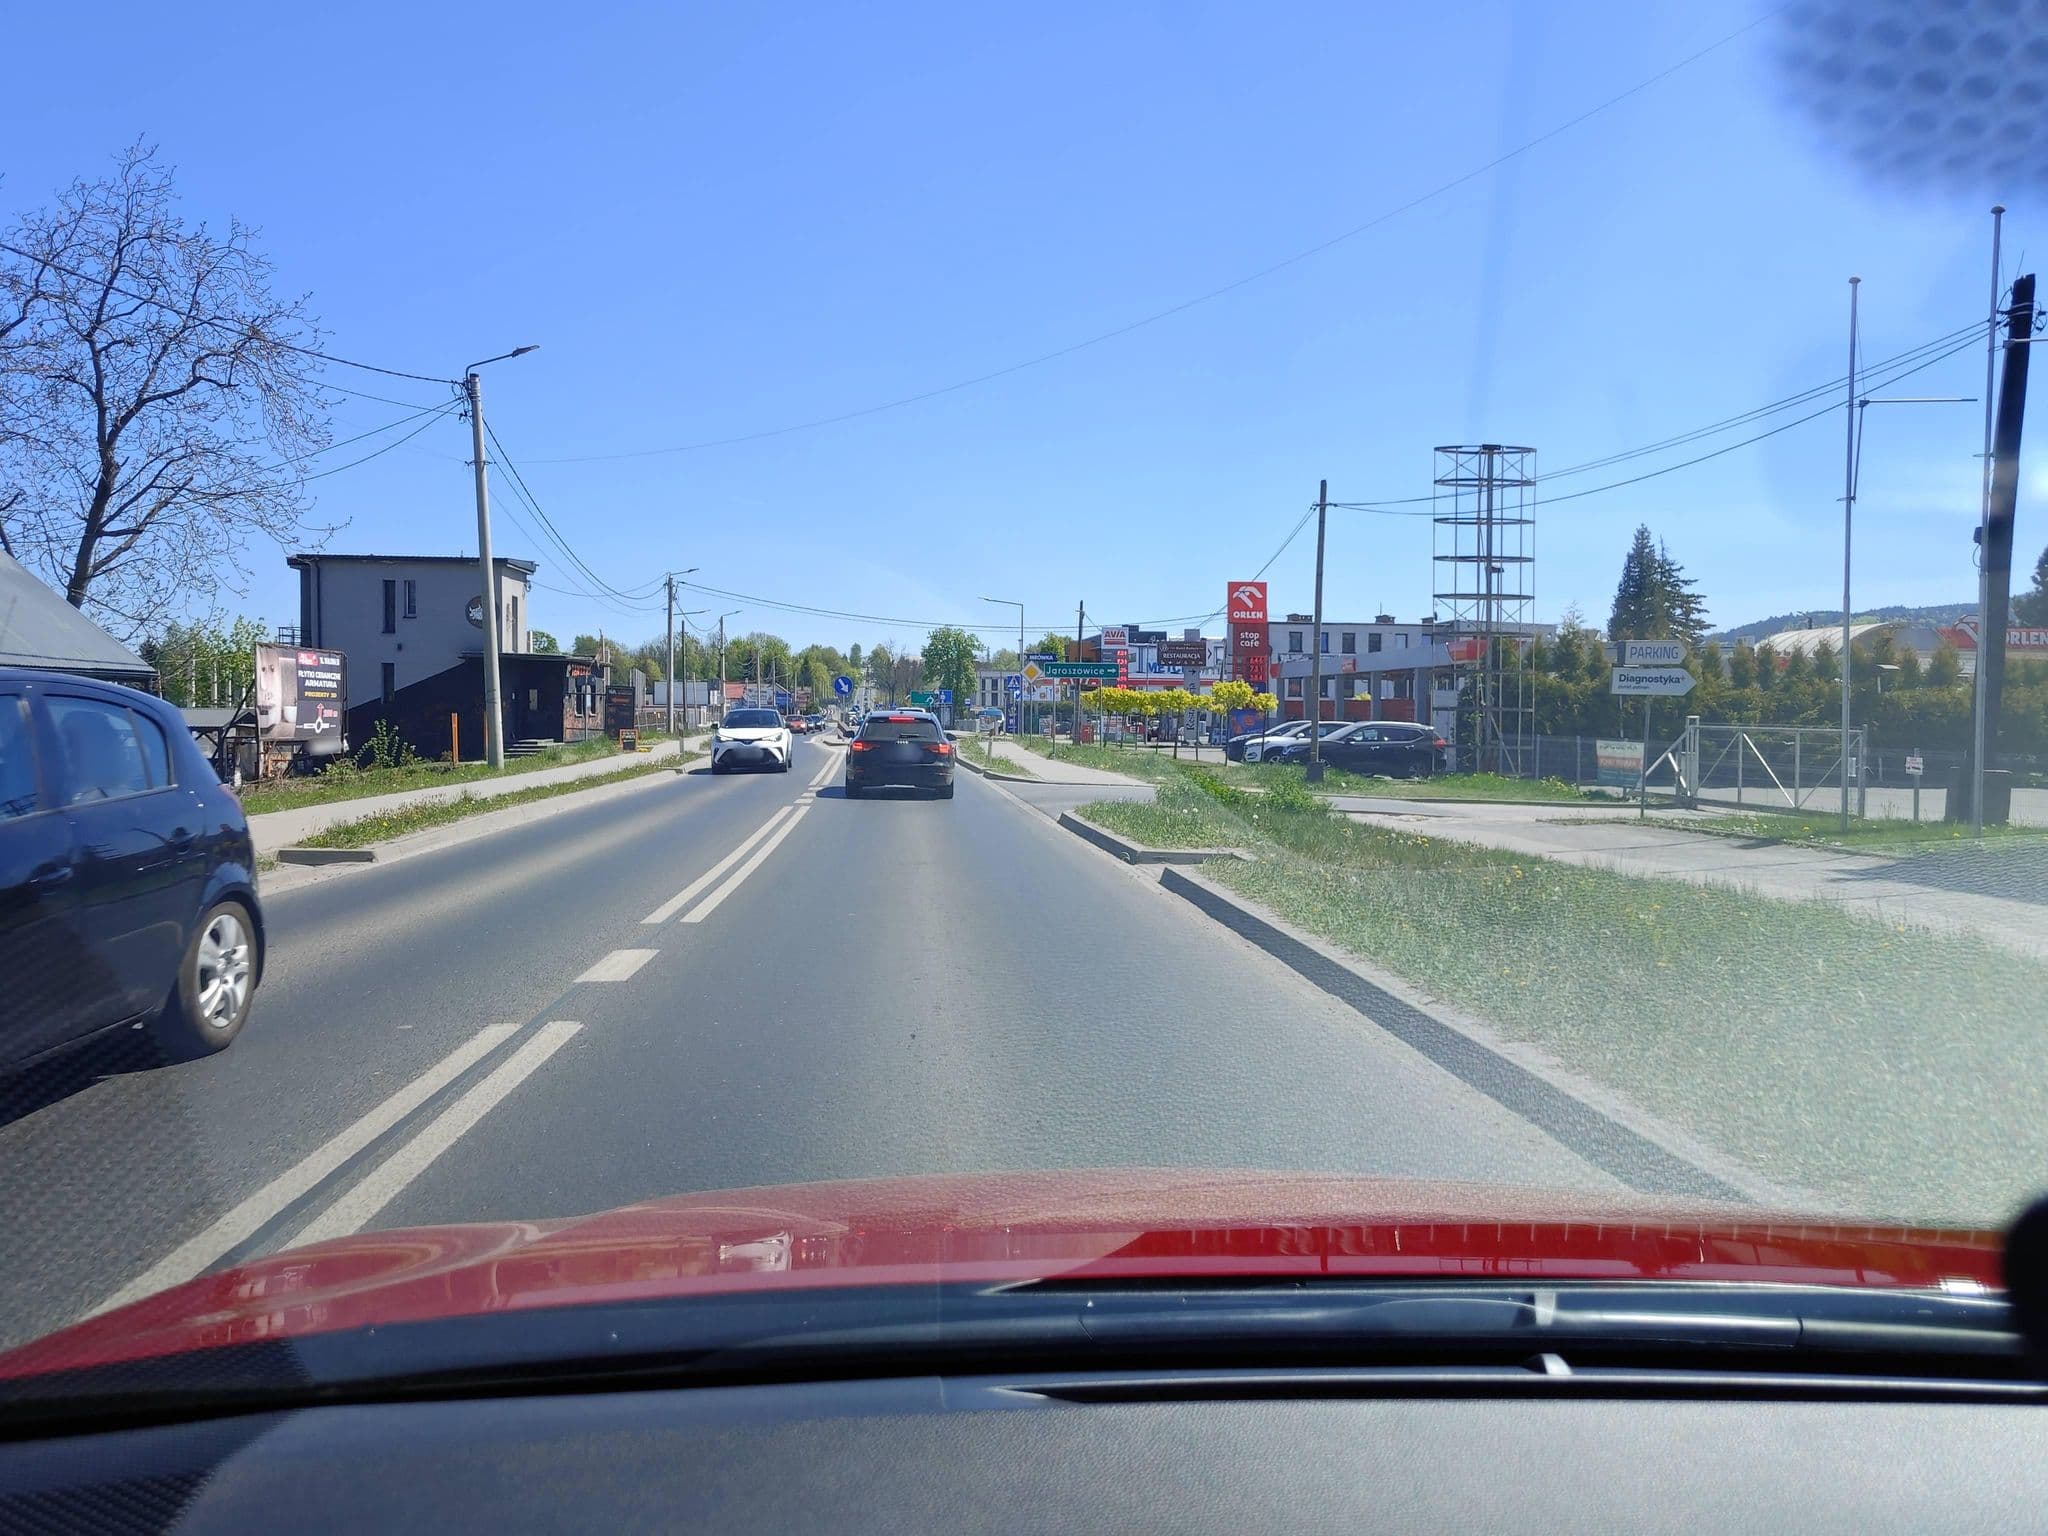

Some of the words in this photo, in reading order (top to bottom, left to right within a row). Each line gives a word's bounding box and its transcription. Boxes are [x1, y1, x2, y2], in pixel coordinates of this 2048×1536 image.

[1233, 611, 1263, 619] ORLEN
[1104, 630, 1126, 638] AVIA
[1240, 631, 1260, 641] stop
[2006, 631, 2048, 645] RLEN
[1630, 646, 1679, 659] PARKING
[1046, 665, 1105, 675] Jaroszowice
[305, 679, 337, 688] ARMATURA
